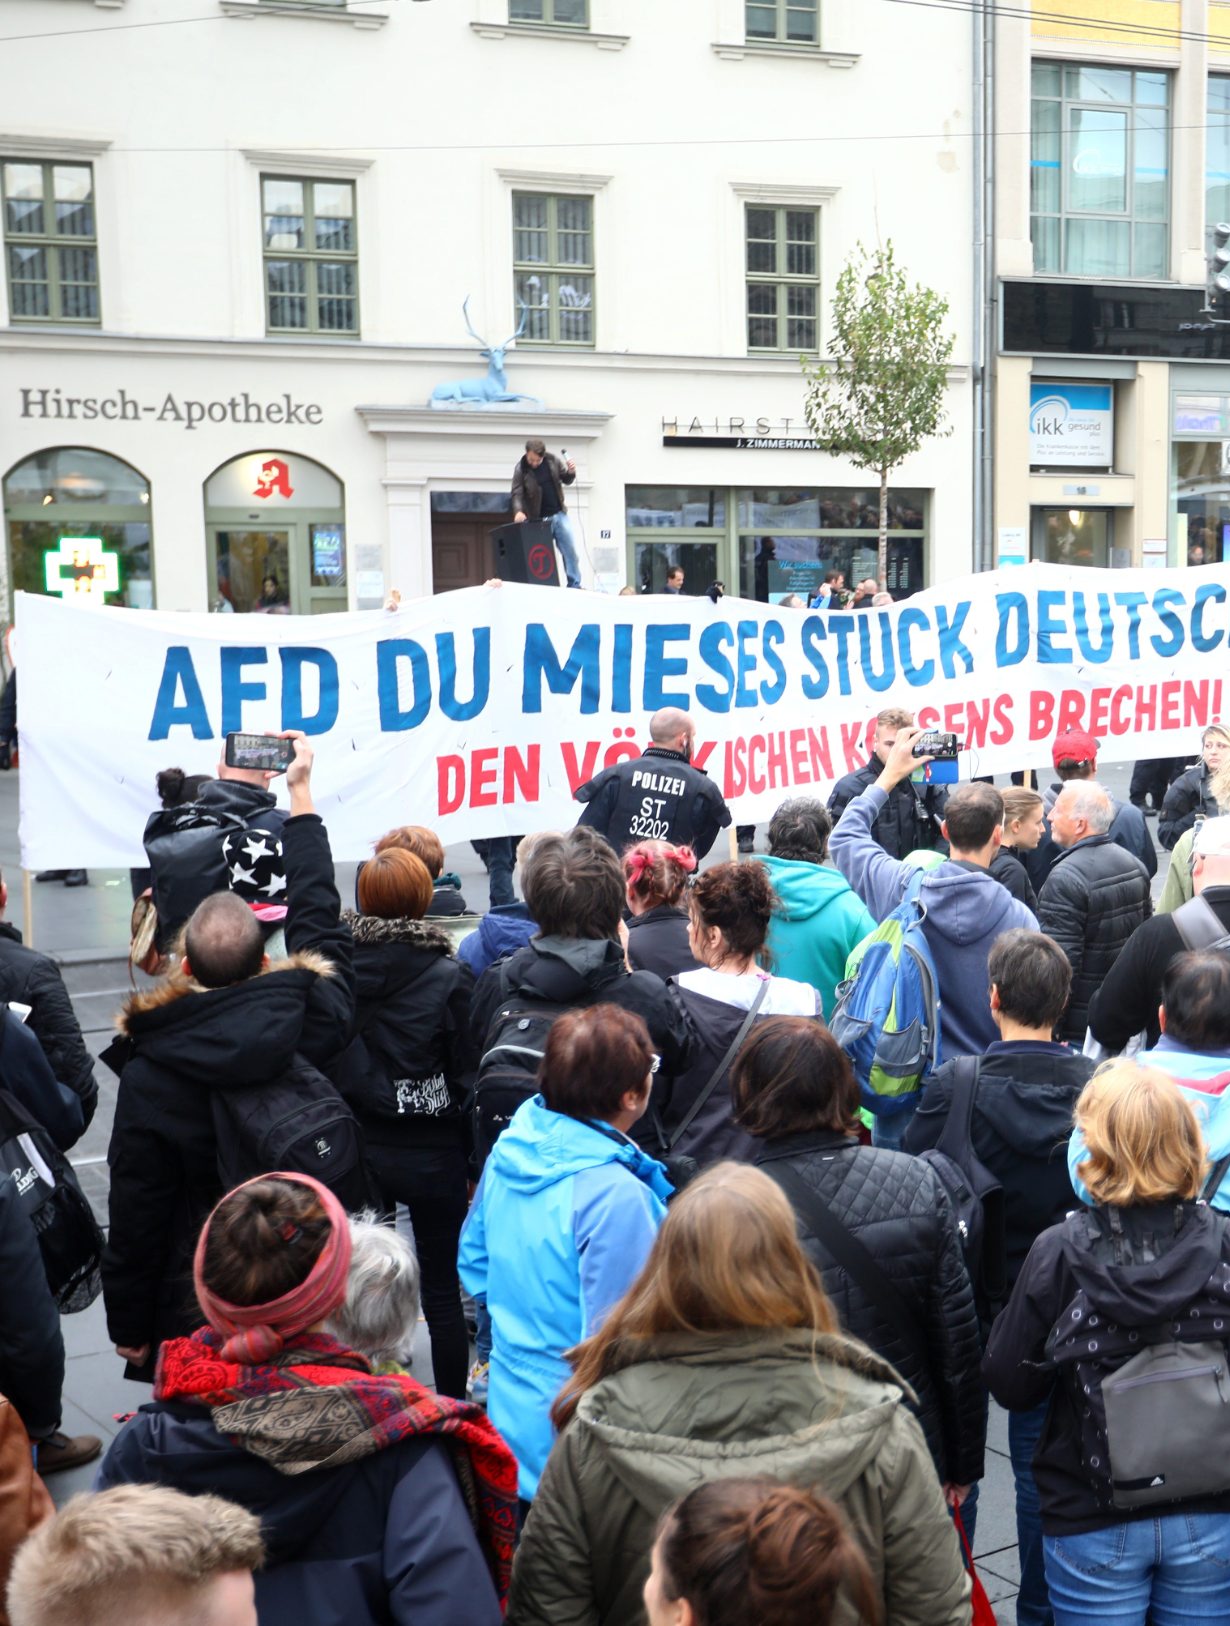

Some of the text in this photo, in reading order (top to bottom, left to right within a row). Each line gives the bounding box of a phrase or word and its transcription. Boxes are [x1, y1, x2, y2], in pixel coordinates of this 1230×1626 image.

[19, 388, 324, 430] Hirsch-Apotheke
[1037, 417, 1063, 435] ikk
[1068, 422, 1101, 432] gesund
[746, 439, 821, 449] ZIMMERMAN
[149, 645, 340, 740] AFD
[377, 625, 491, 731] DU
[522, 616, 787, 714] MIESES
[438, 680, 1223, 816] DEN VÖKISCHEN KOSENS BRECHEN!
[631, 770, 686, 797] POLIZEI
[640, 796, 667, 819] ST
[629, 814, 669, 841] 32202
